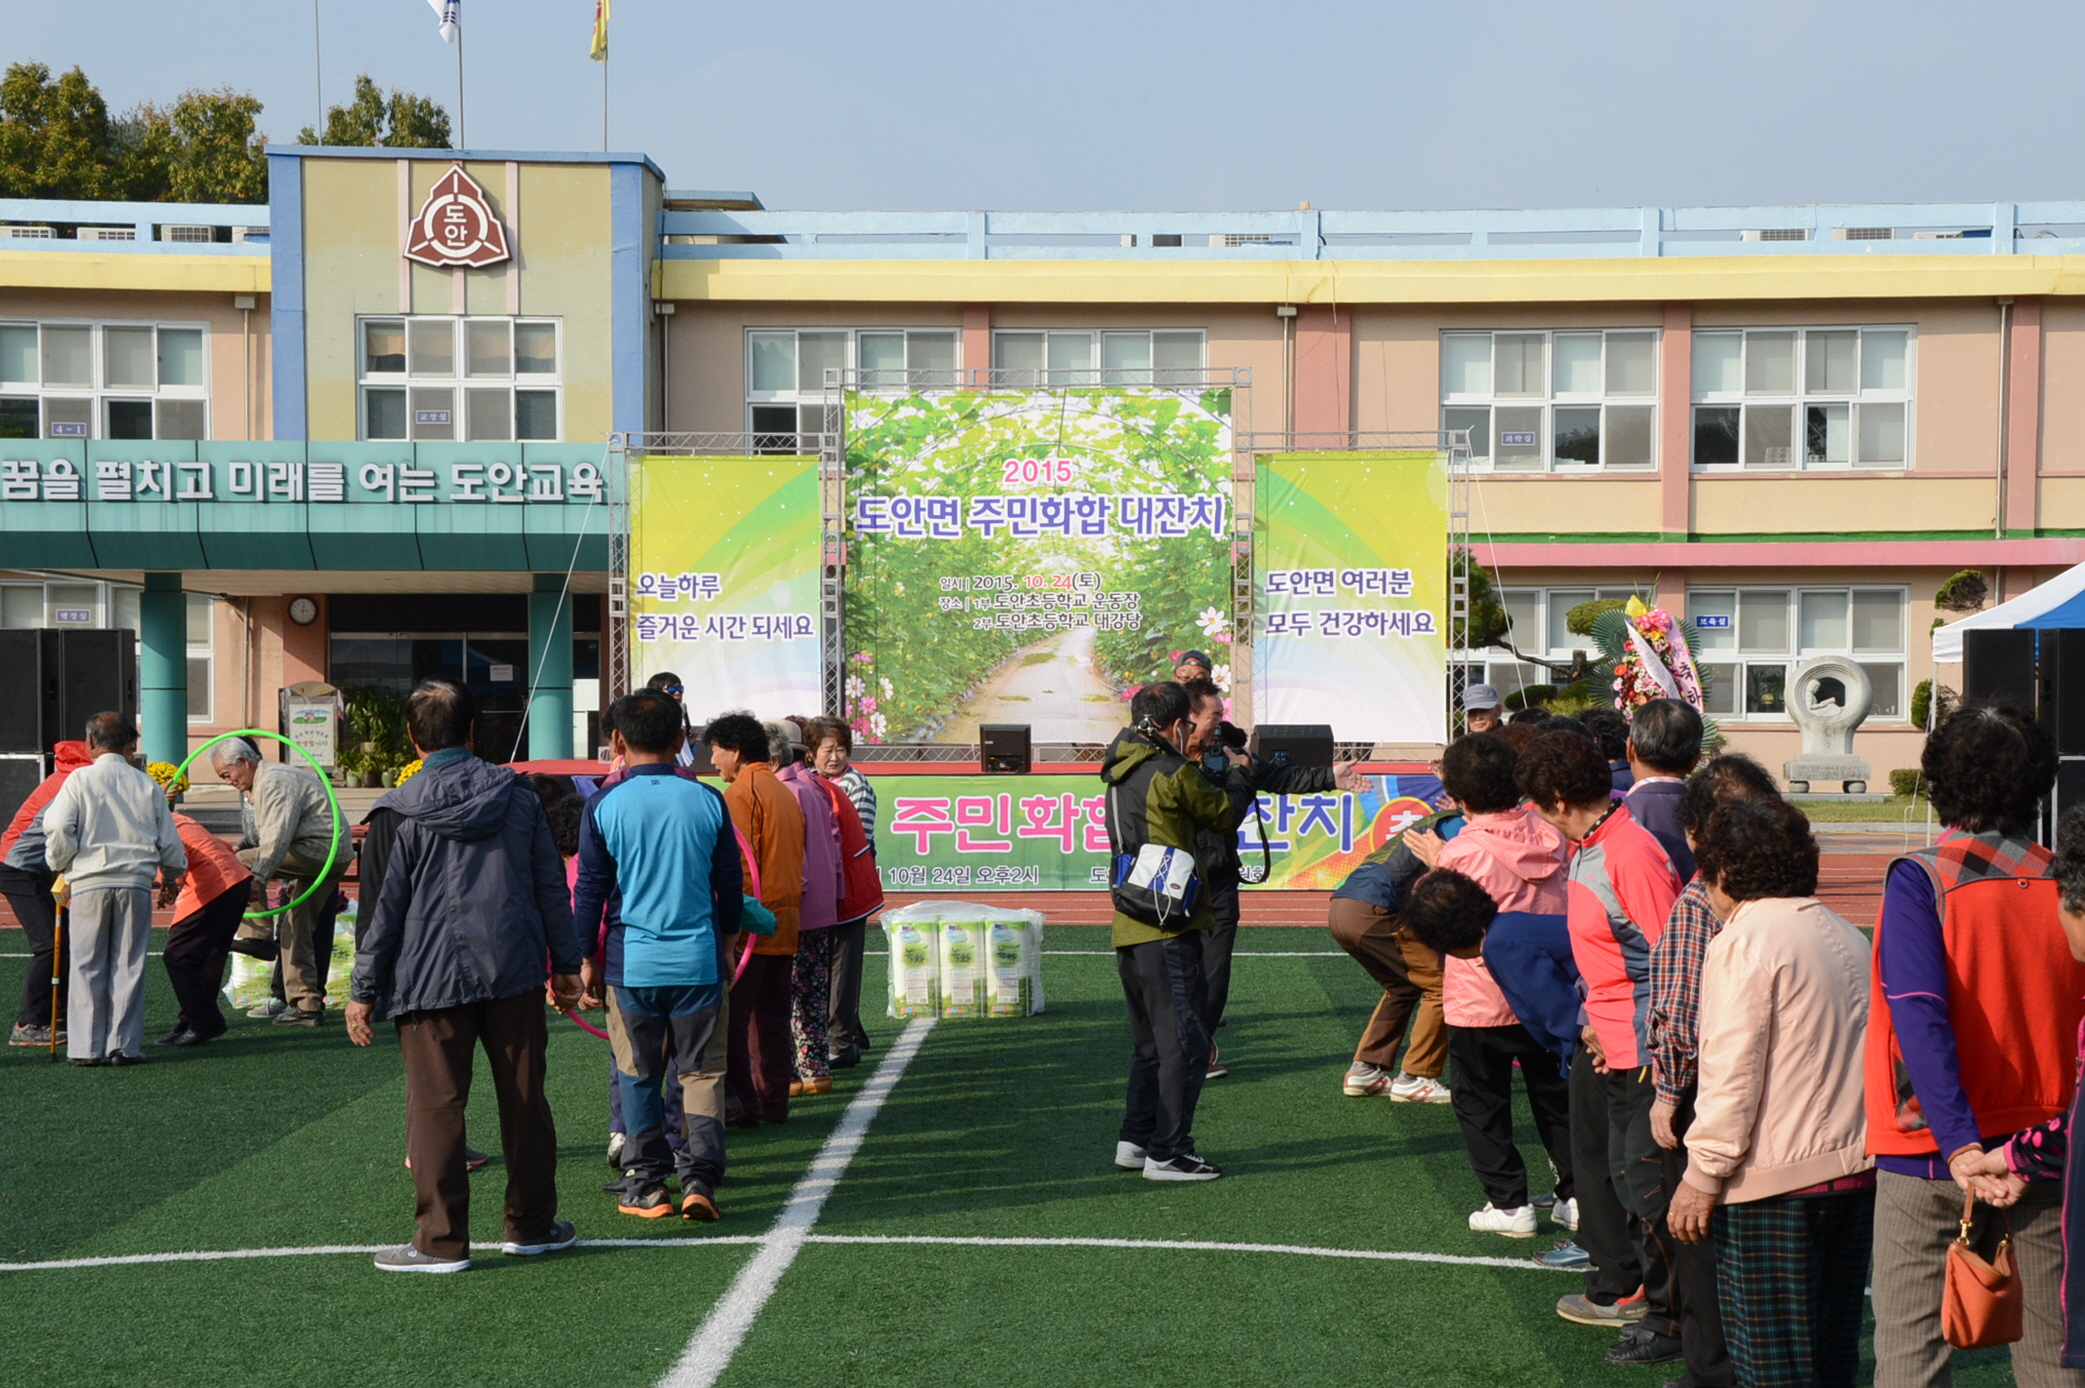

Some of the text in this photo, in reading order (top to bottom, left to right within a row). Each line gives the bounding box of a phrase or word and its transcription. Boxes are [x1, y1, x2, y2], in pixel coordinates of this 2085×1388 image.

[2, 459, 603, 503] 꿈을 펼치고 미래를 여는 도안교육
[1004, 460, 1072, 483] 2015
[855, 496, 1224, 537] 도안면 주민화합 대잔치
[637, 574, 720, 600] 오늘하루
[940, 578, 963, 590] 일시
[973, 576, 1018, 591] 2015.
[1023, 575, 1048, 588] 10.
[1266, 571, 1411, 595] 도안면 여러분
[940, 593, 1139, 610] 장소 1부 도안초등학교 운동장
[637, 615, 814, 640] 즐거운 시간 되세요
[974, 613, 1141, 630] 2부 도안초등학교 대강당
[1266, 612, 1435, 637] 모두 건강하세요
[889, 867, 926, 884] 10월
[932, 867, 971, 884] 24일
[977, 866, 1039, 884] 오후2시
